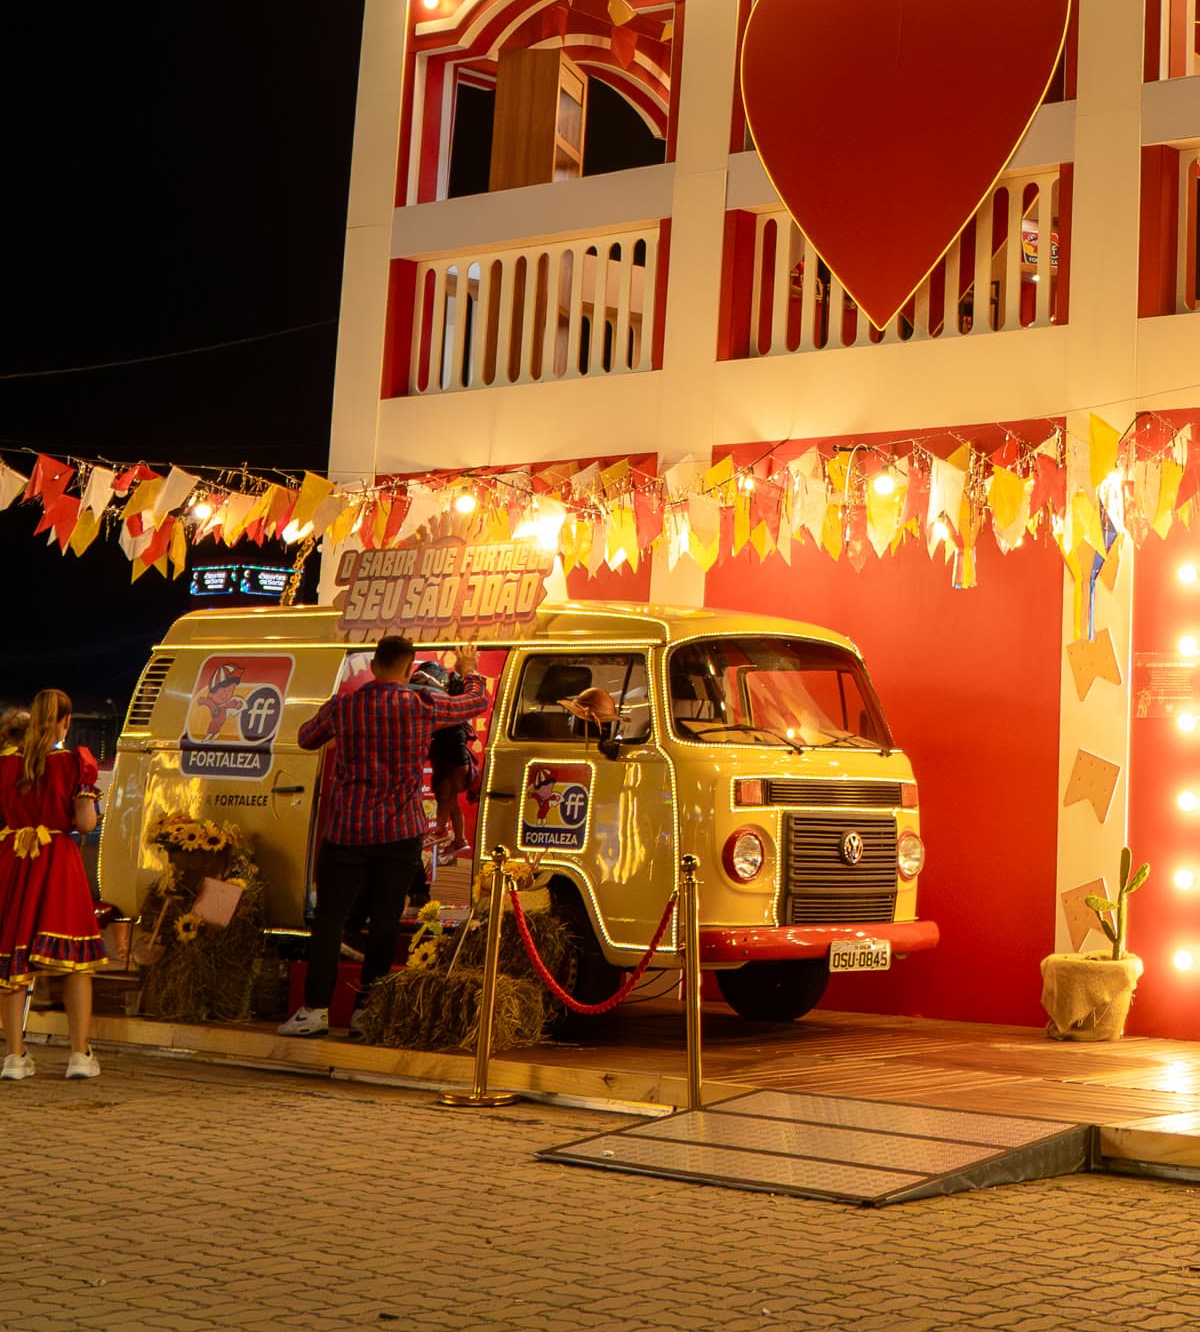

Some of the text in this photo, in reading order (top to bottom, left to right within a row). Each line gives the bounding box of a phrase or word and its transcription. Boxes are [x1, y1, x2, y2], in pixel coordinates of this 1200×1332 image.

[341, 553, 358, 579] O
[359, 549, 417, 579] SABOR
[421, 547, 457, 578] QUE
[345, 572, 540, 620] SEU SÃO JOÃO
[248, 698, 276, 734] ff
[188, 751, 261, 769] FORTALEZA
[214, 795, 269, 807] FORTALECE
[565, 793, 585, 820] ff
[525, 832, 578, 845] FORTALEZA
